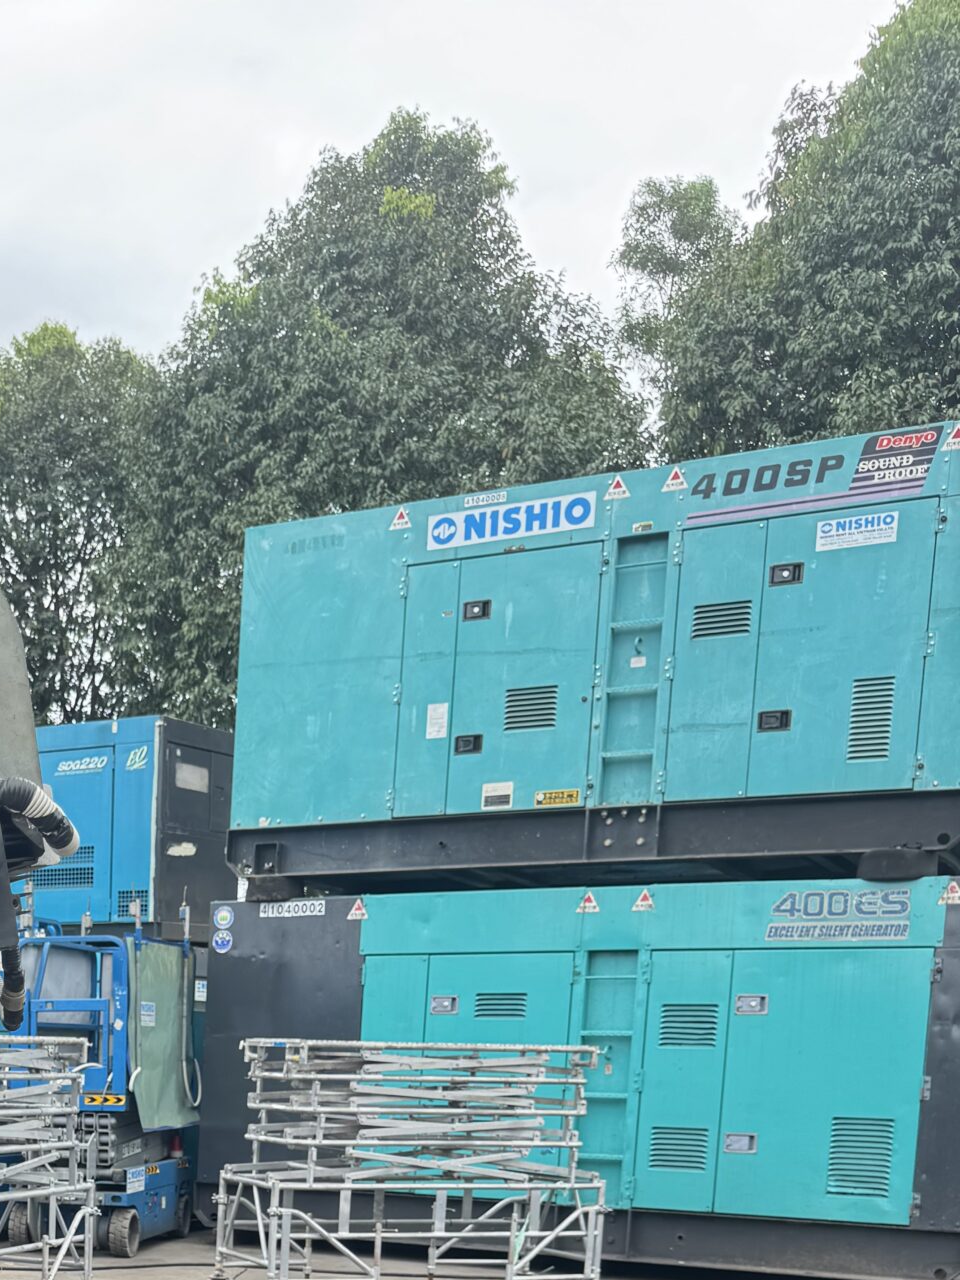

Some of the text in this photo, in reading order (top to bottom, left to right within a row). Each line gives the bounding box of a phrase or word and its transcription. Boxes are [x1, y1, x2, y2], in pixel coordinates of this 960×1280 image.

[875, 431, 937, 450] Denyo
[858, 454, 914, 473] SOUND
[690, 454, 845, 500] 400SP
[872, 465, 929, 483] PROOF
[463, 497, 592, 541] NISHIO
[836, 514, 895, 533] NISHIO
[260, 902, 324, 917] 41040002
[818, 922, 851, 938] SILENT
[851, 921, 909, 938] GENERATOR
